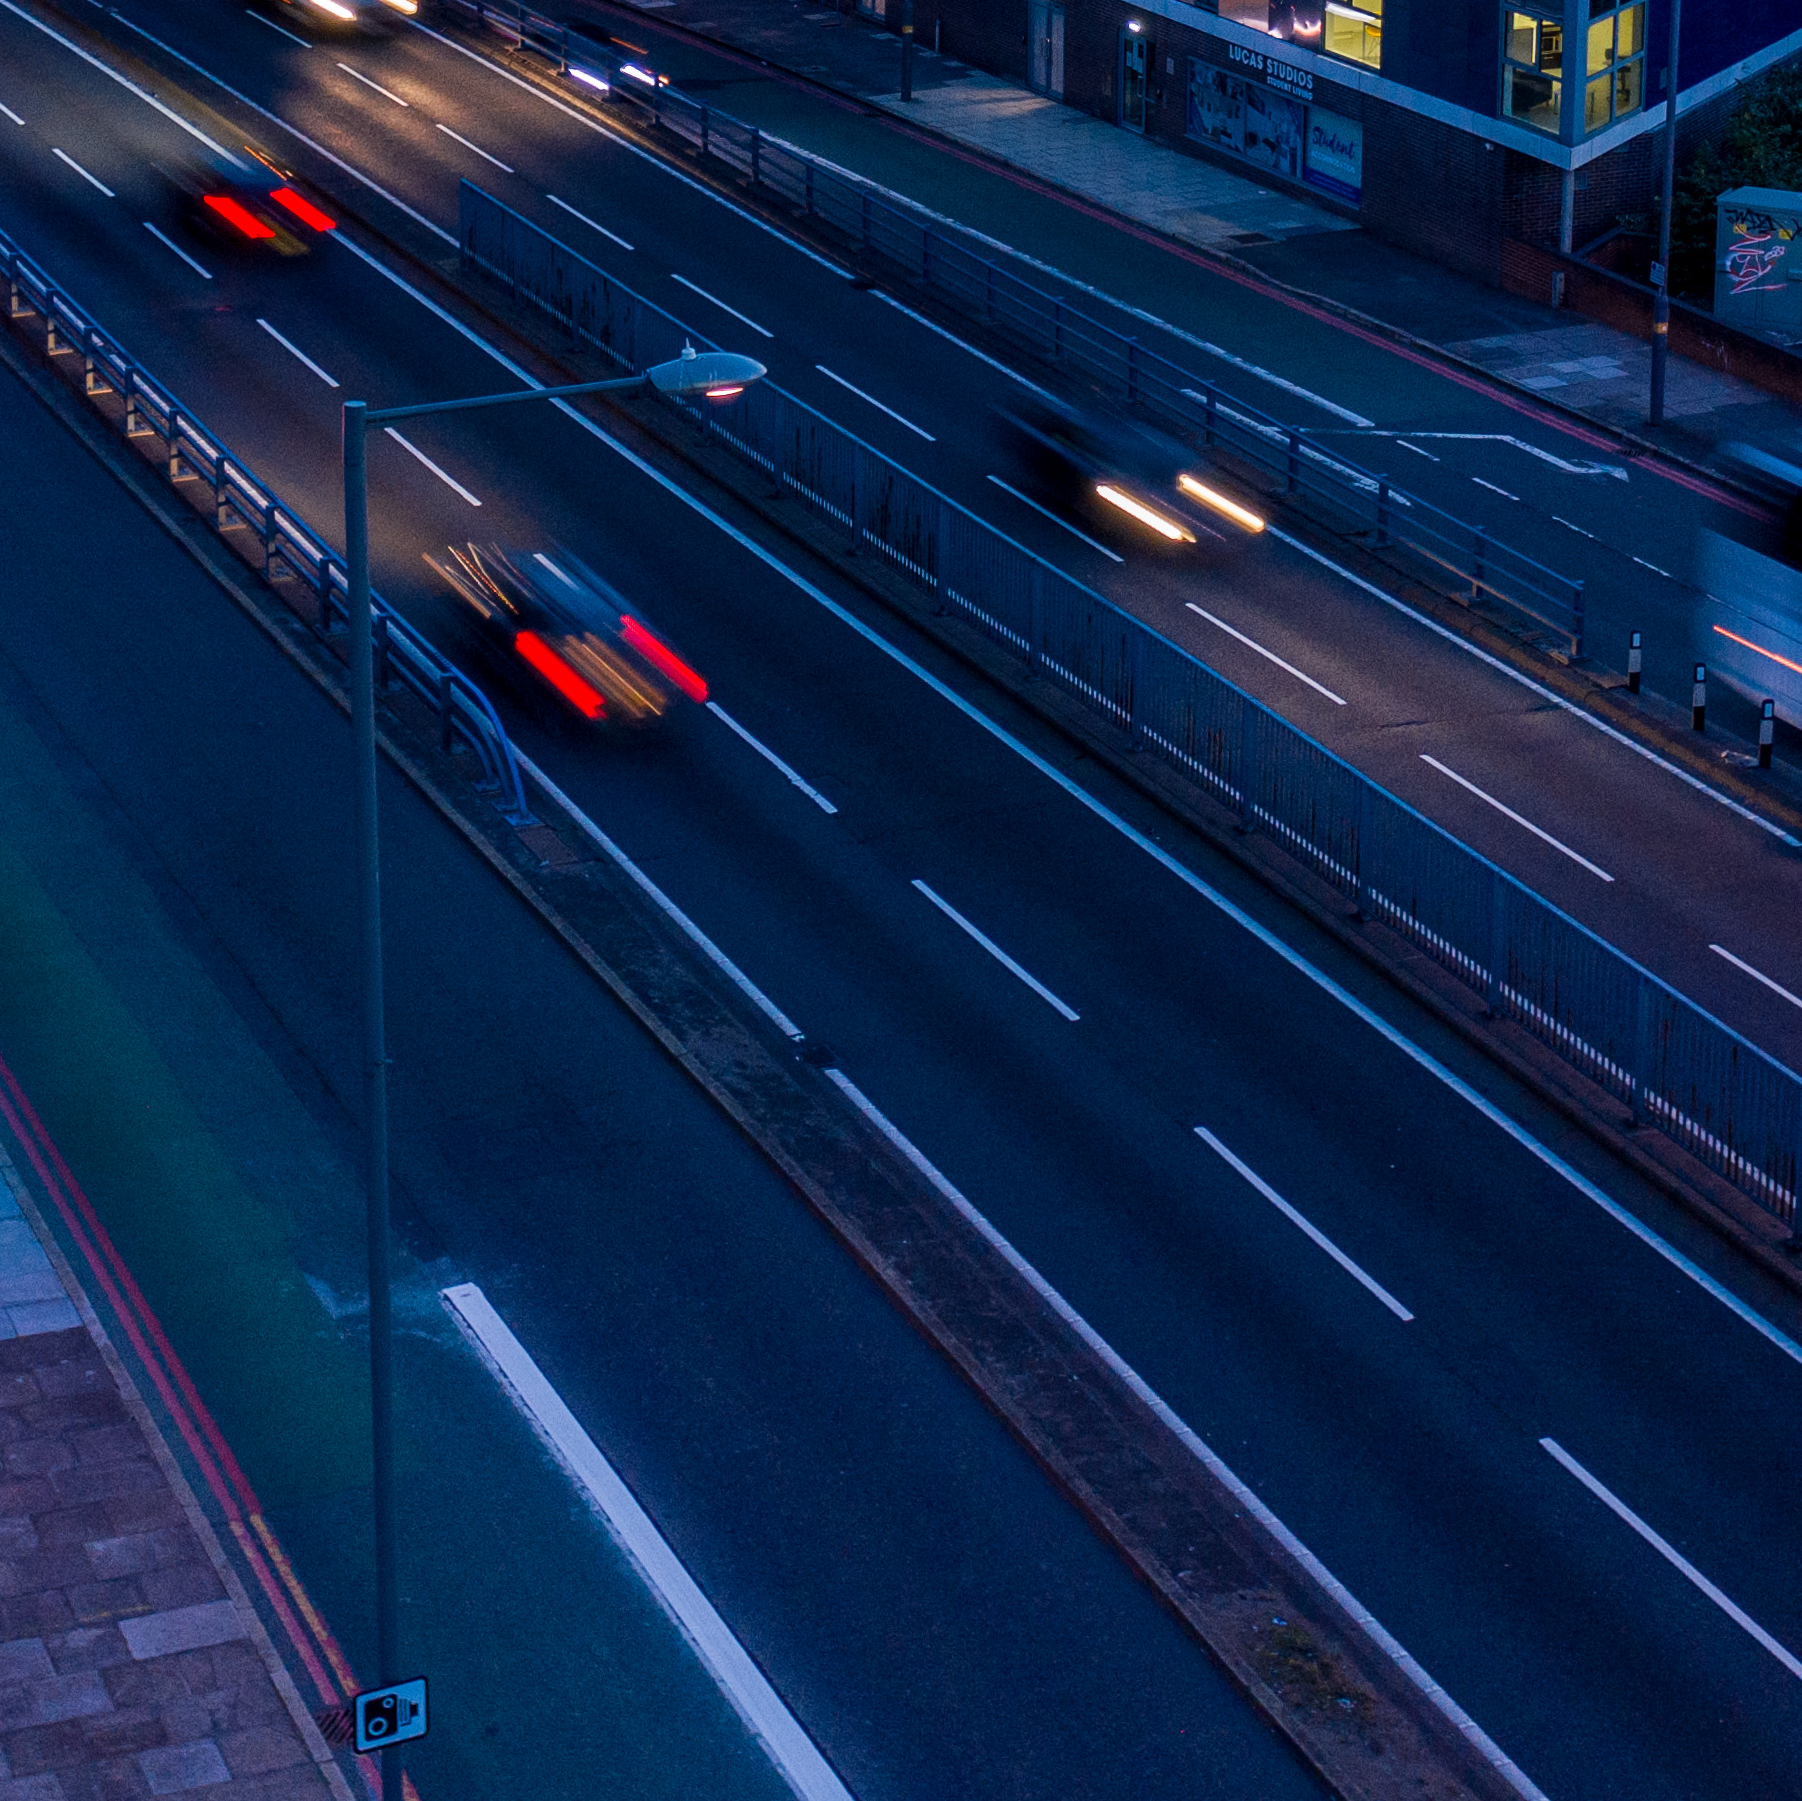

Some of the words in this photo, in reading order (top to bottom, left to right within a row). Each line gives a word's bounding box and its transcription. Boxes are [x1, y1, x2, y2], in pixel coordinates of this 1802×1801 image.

[1229, 44, 1264, 70] LUCAS
[1266, 58, 1313, 89] STUDIOS
[1266, 75, 1292, 93] STUDENT
[1292, 85, 1313, 101] LIVING
[1312, 126, 1355, 159] Student
